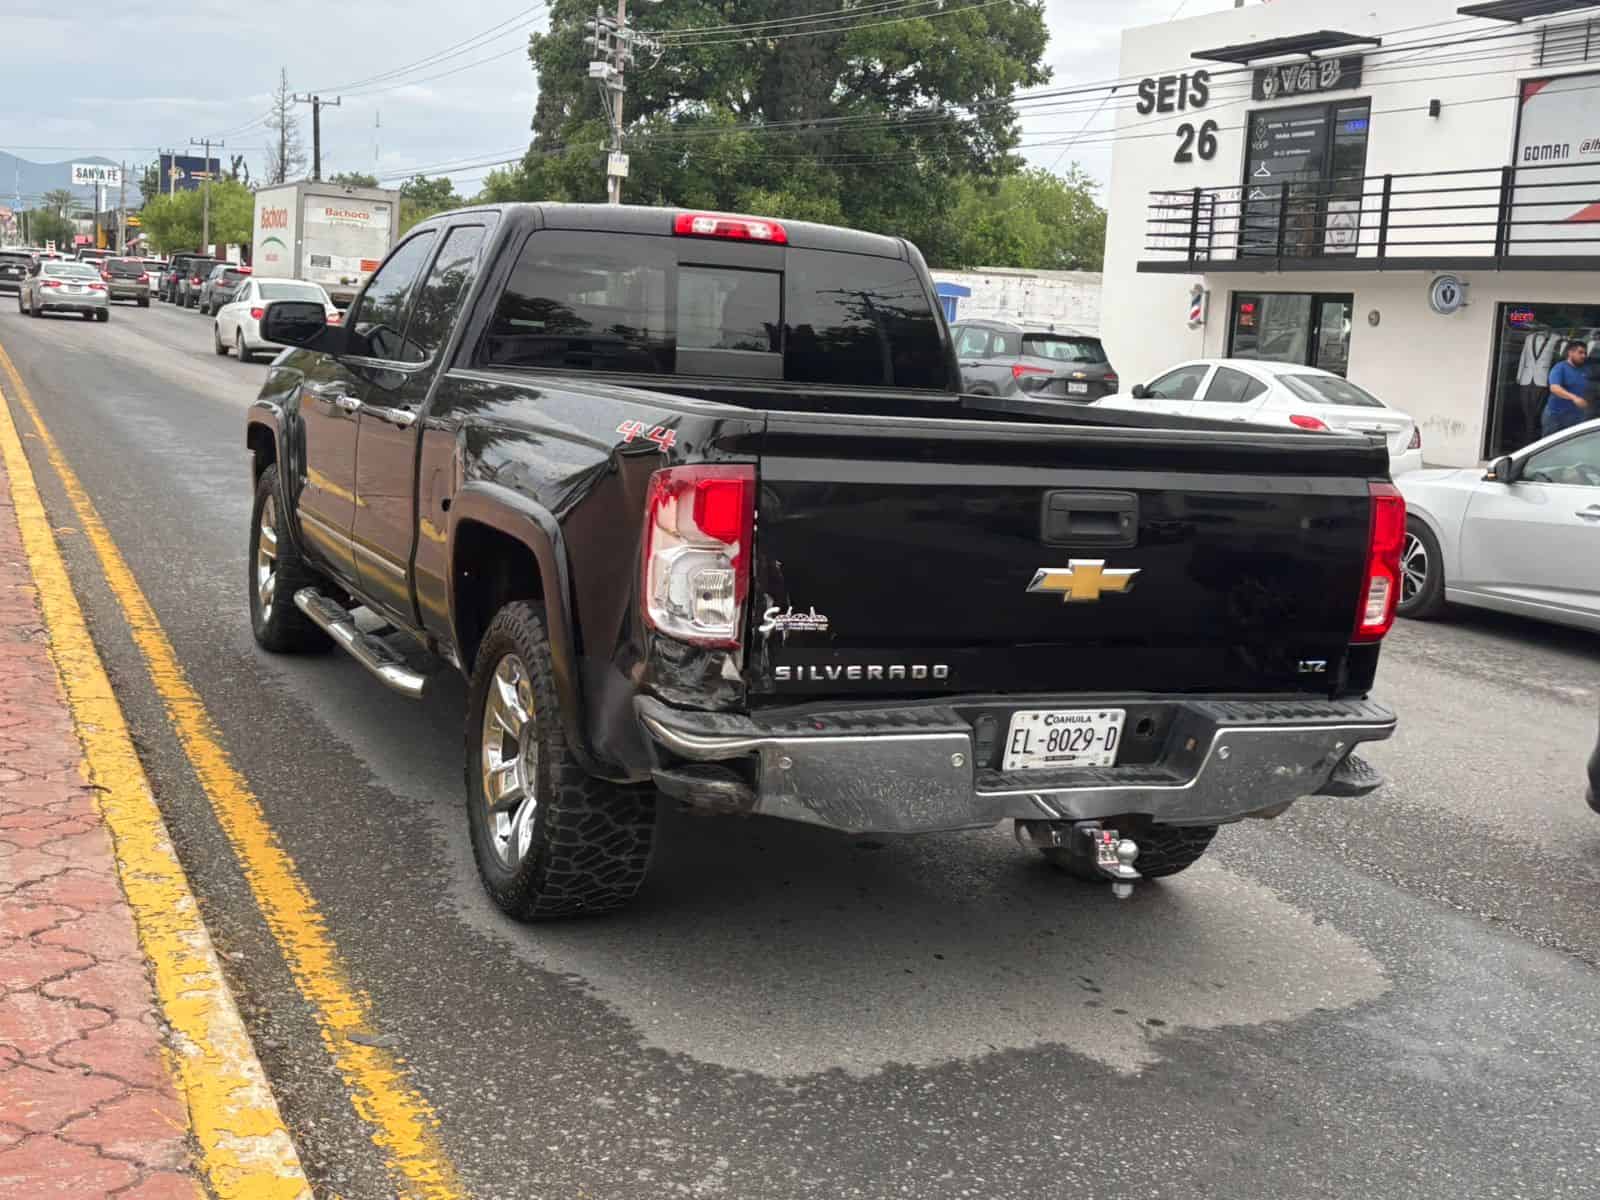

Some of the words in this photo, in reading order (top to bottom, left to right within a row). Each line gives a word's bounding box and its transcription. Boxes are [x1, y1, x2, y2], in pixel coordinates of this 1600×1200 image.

[1136, 69, 1209, 114] SEIS
[1173, 119, 1218, 162] 26
[325, 206, 370, 220] Bachoco
[774, 664, 949, 681] SILVERADO
[1299, 660, 1327, 673] LTZ
[1010, 726, 1118, 754] EL-8029-D
